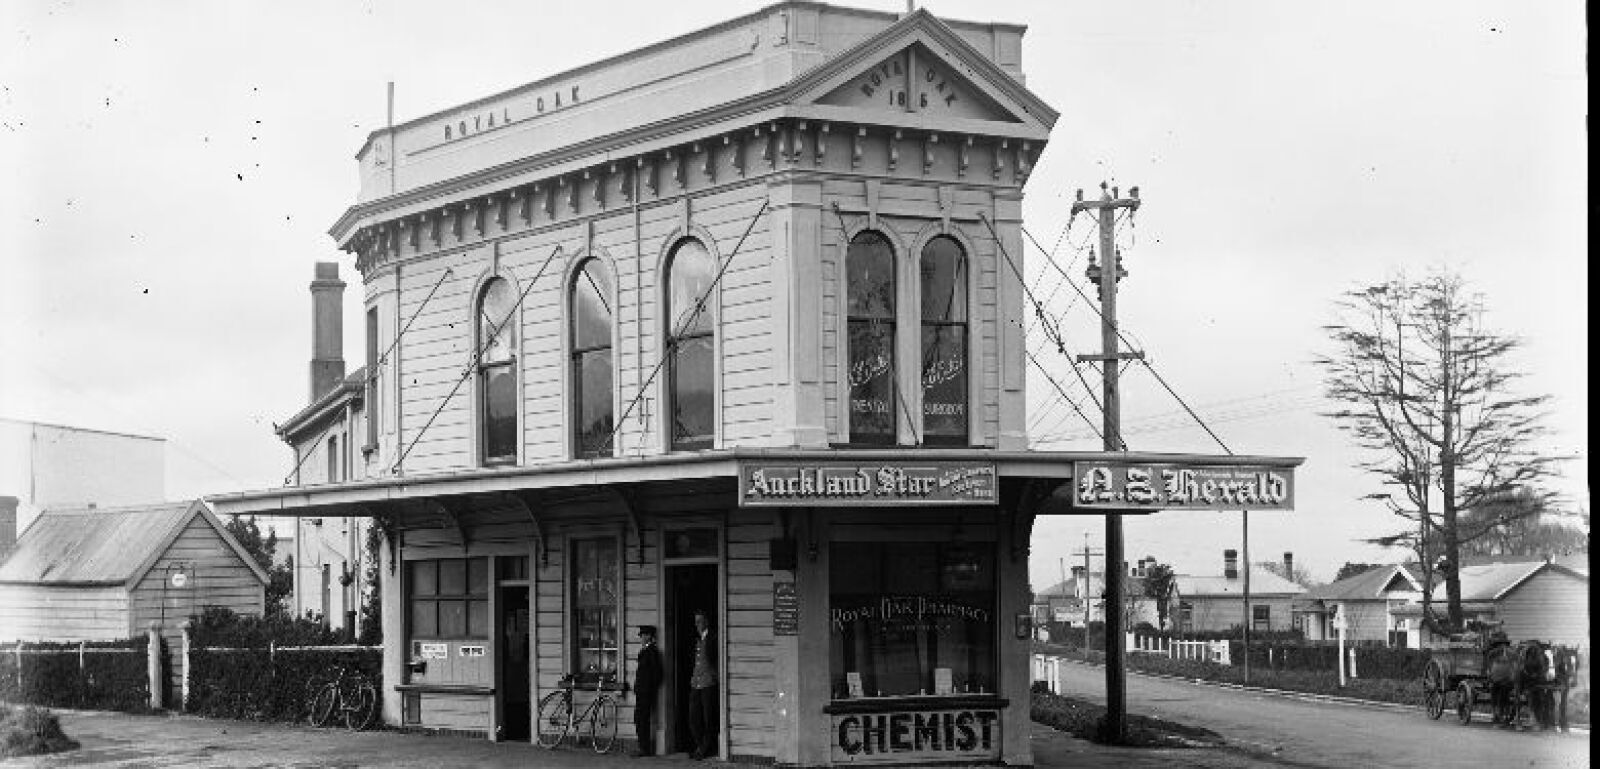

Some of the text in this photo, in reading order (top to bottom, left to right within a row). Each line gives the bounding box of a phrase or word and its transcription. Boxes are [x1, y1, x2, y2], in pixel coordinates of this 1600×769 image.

[926, 68, 957, 107] OAK
[444, 85, 580, 140] ROYAL OAK
[746, 467, 871, 498] Auckland
[874, 464, 936, 498] Star
[1161, 468, 1288, 505] Herald
[838, 710, 998, 755] CHEMIST
